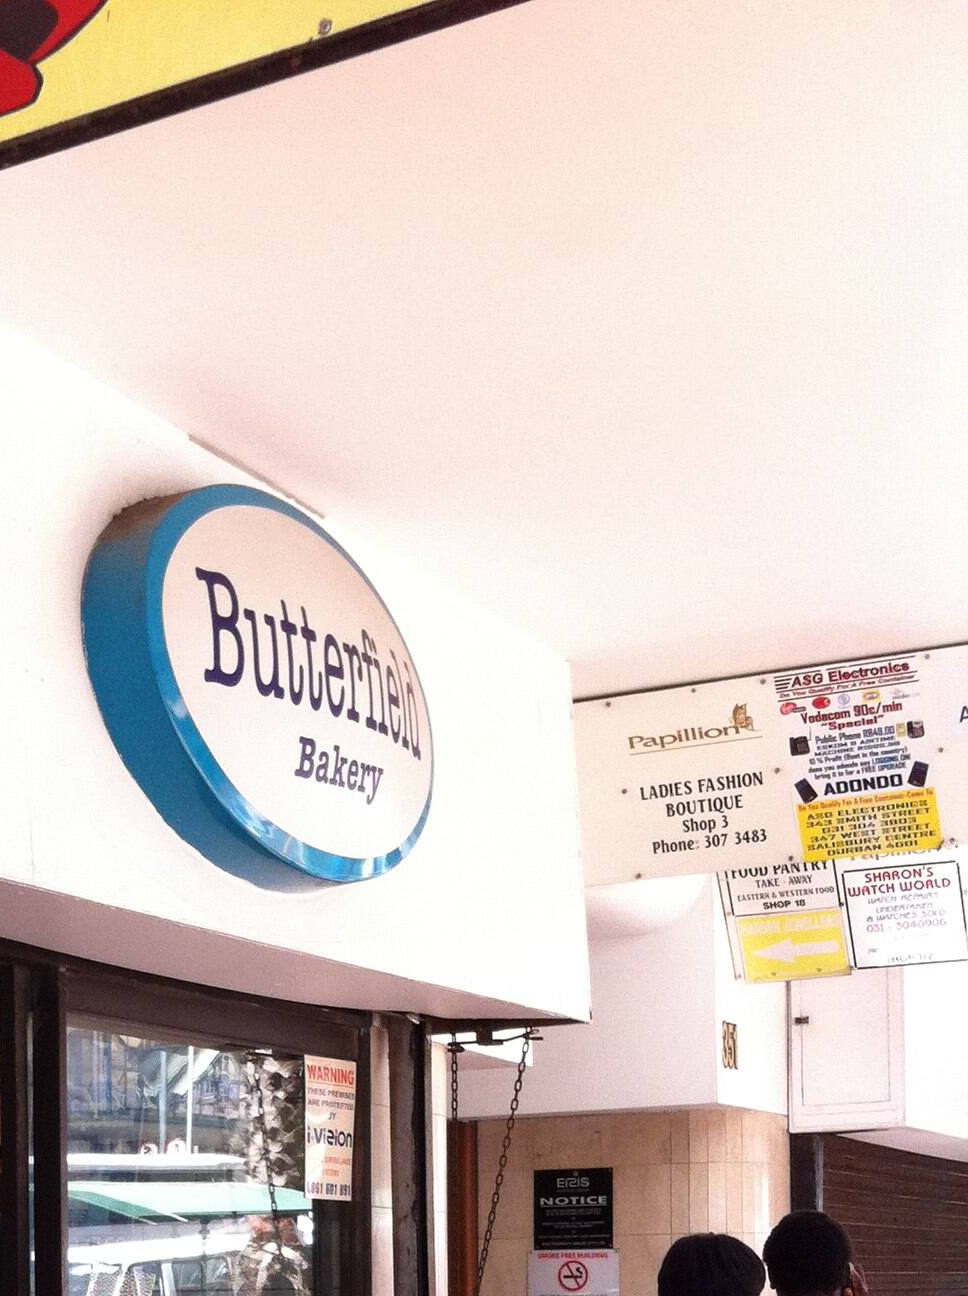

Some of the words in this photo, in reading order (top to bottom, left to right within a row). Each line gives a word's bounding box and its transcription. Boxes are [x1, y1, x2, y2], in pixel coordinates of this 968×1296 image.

[195, 566, 421, 761] Butterfield
[792, 673, 823, 688] ASG
[828, 662, 910, 683] Electronics
[801, 709, 851, 724] Vodacom
[628, 725, 740, 749] Papillion
[295, 736, 384, 805] Bakery
[639, 780, 693, 801] LADIES
[697, 771, 764, 793] FASHION
[824, 773, 903, 796] ADONDO
[665, 794, 744, 818] BOUTIQUE
[837, 800, 929, 817] ELECTRONICS
[682, 818, 716, 833] Shop
[721, 815, 729, 829] 3
[836, 814, 877, 824] SMITH
[882, 807, 931, 819] STREET
[840, 829, 876, 839] WEST
[882, 823, 931, 834] STREET
[652, 838, 700, 854] Phone:
[704, 833, 728, 849] 307
[734, 828, 767, 845] 3483
[807, 837, 881, 851] SALISBURY
[885, 830, 937, 842] CENTRE
[827, 845, 881, 857] DURBAN
[755, 878, 780, 889] TAKE
[788, 874, 813, 886] AWAY
[864, 865, 934, 883] SHARON'S
[737, 891, 770, 902] EASTERN
[778, 888, 814, 898] WESTERN
[815, 886, 835, 894] FOOD
[848, 883, 895, 898] WATCH
[899, 877, 951, 892] WORLD
[763, 900, 791, 910] SHOP
[866, 924, 884, 933] 031
[307, 1064, 354, 1085] WARNING
[539, 1195, 608, 1207] NOTICE
